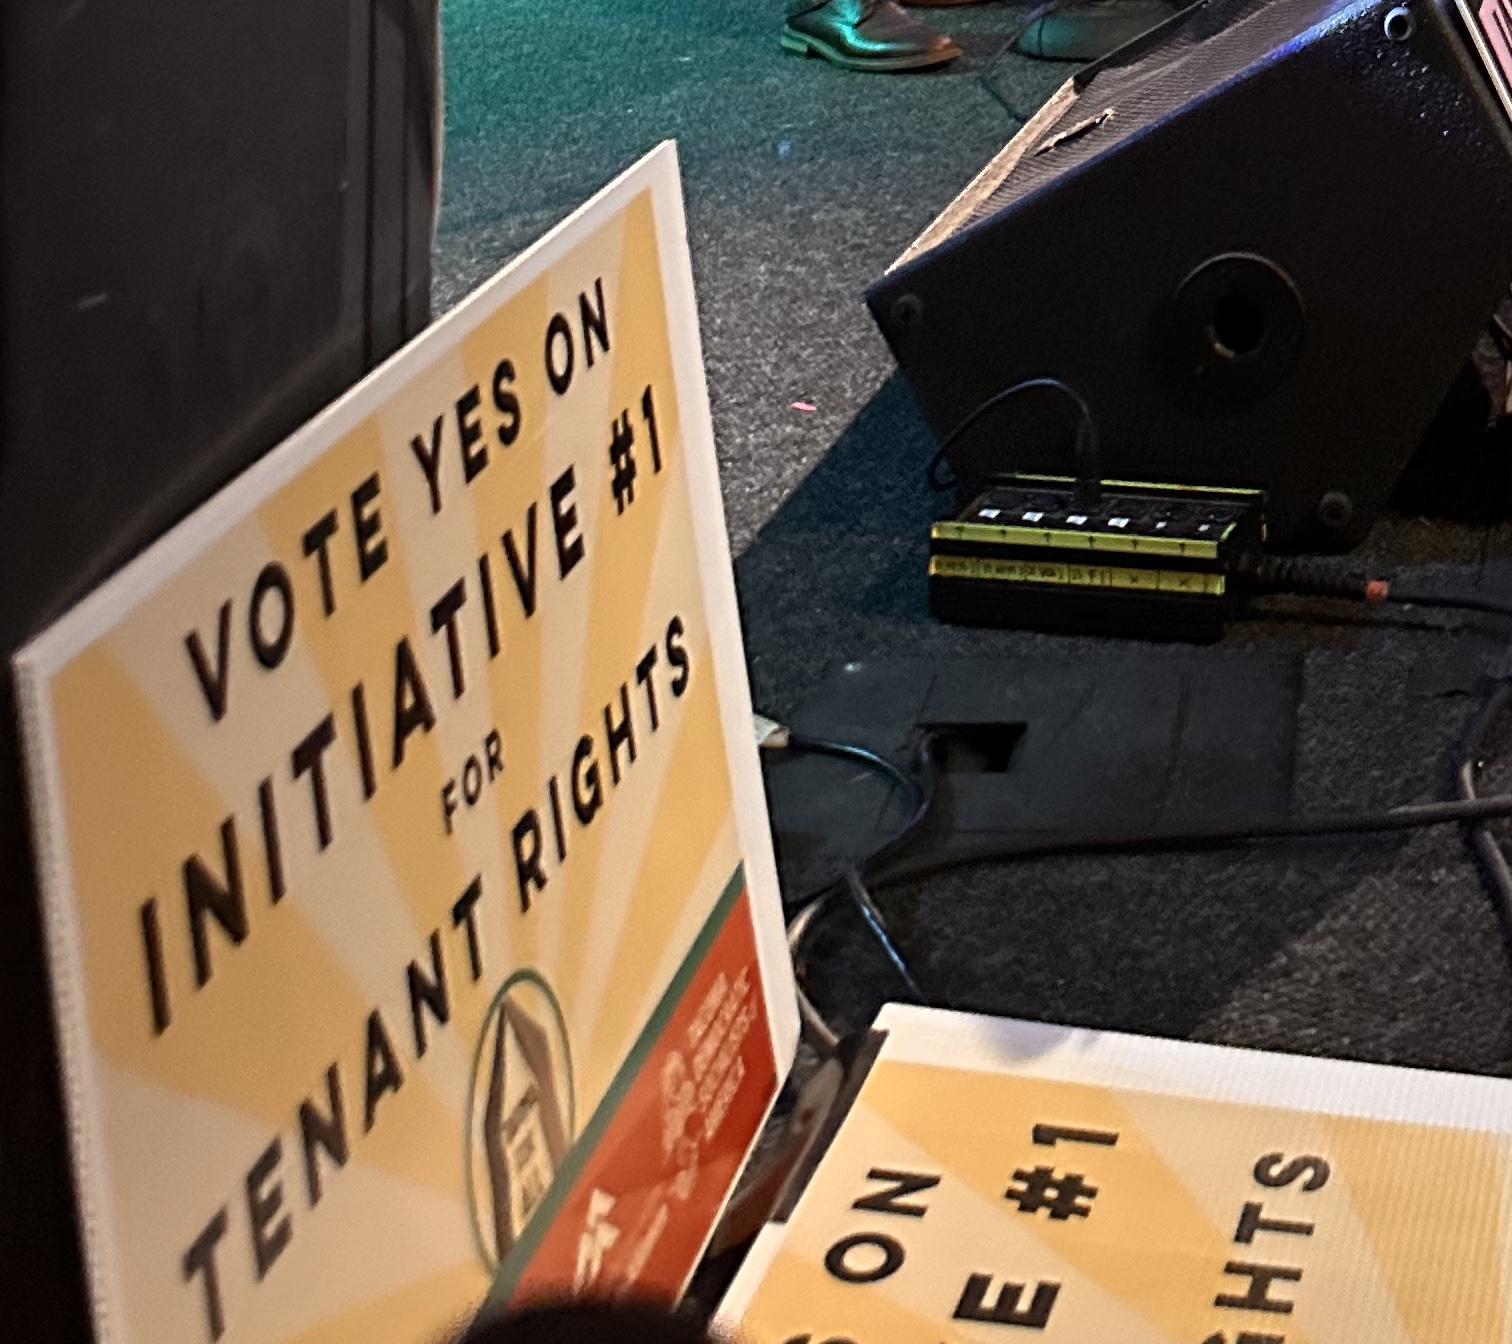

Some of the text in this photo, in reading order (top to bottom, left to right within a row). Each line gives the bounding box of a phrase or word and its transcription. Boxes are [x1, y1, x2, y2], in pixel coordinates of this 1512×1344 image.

[185, 277, 611, 723] VOTE YES ON
[140, 384, 662, 1037] INITIATIVE #1
[440, 728, 503, 835] FOR
[181, 615, 690, 1343] TENANT RIGHTS
[823, 1166, 941, 1285] ON
[952, 1123, 1119, 1330] E #1
